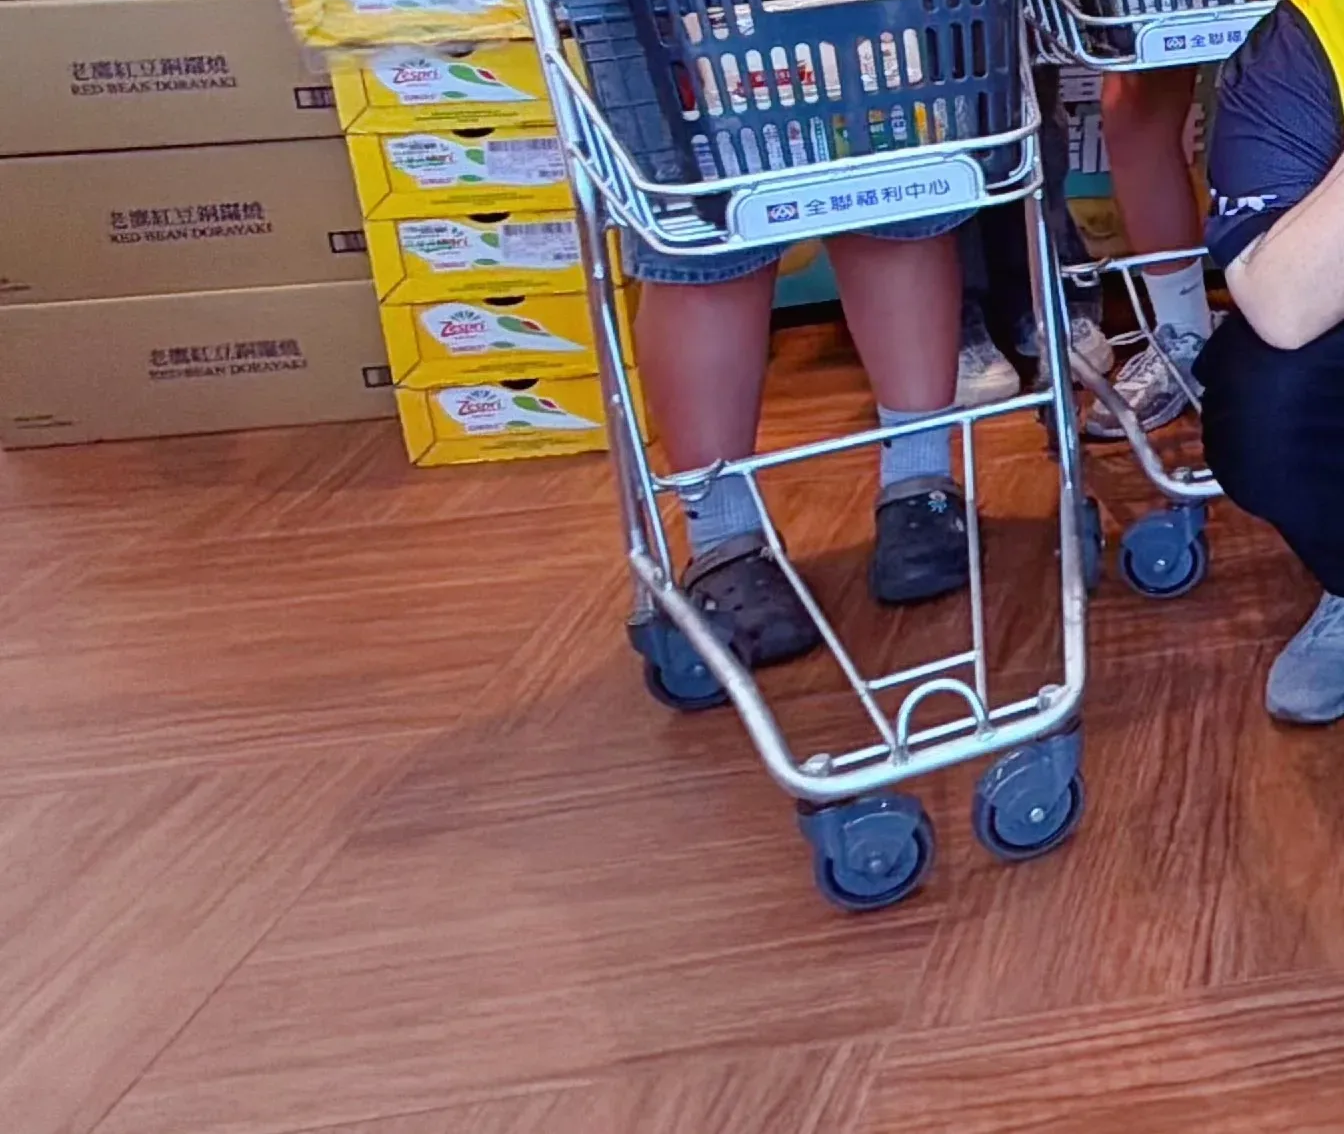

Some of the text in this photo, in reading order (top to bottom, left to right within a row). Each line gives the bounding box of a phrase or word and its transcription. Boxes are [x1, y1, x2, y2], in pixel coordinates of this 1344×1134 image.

[392, 66, 442, 84] Zespri
[804, 178, 951, 217] 全聯福利中心
[439, 319, 487, 338] Zespri
[455, 399, 503, 417] Zespri
